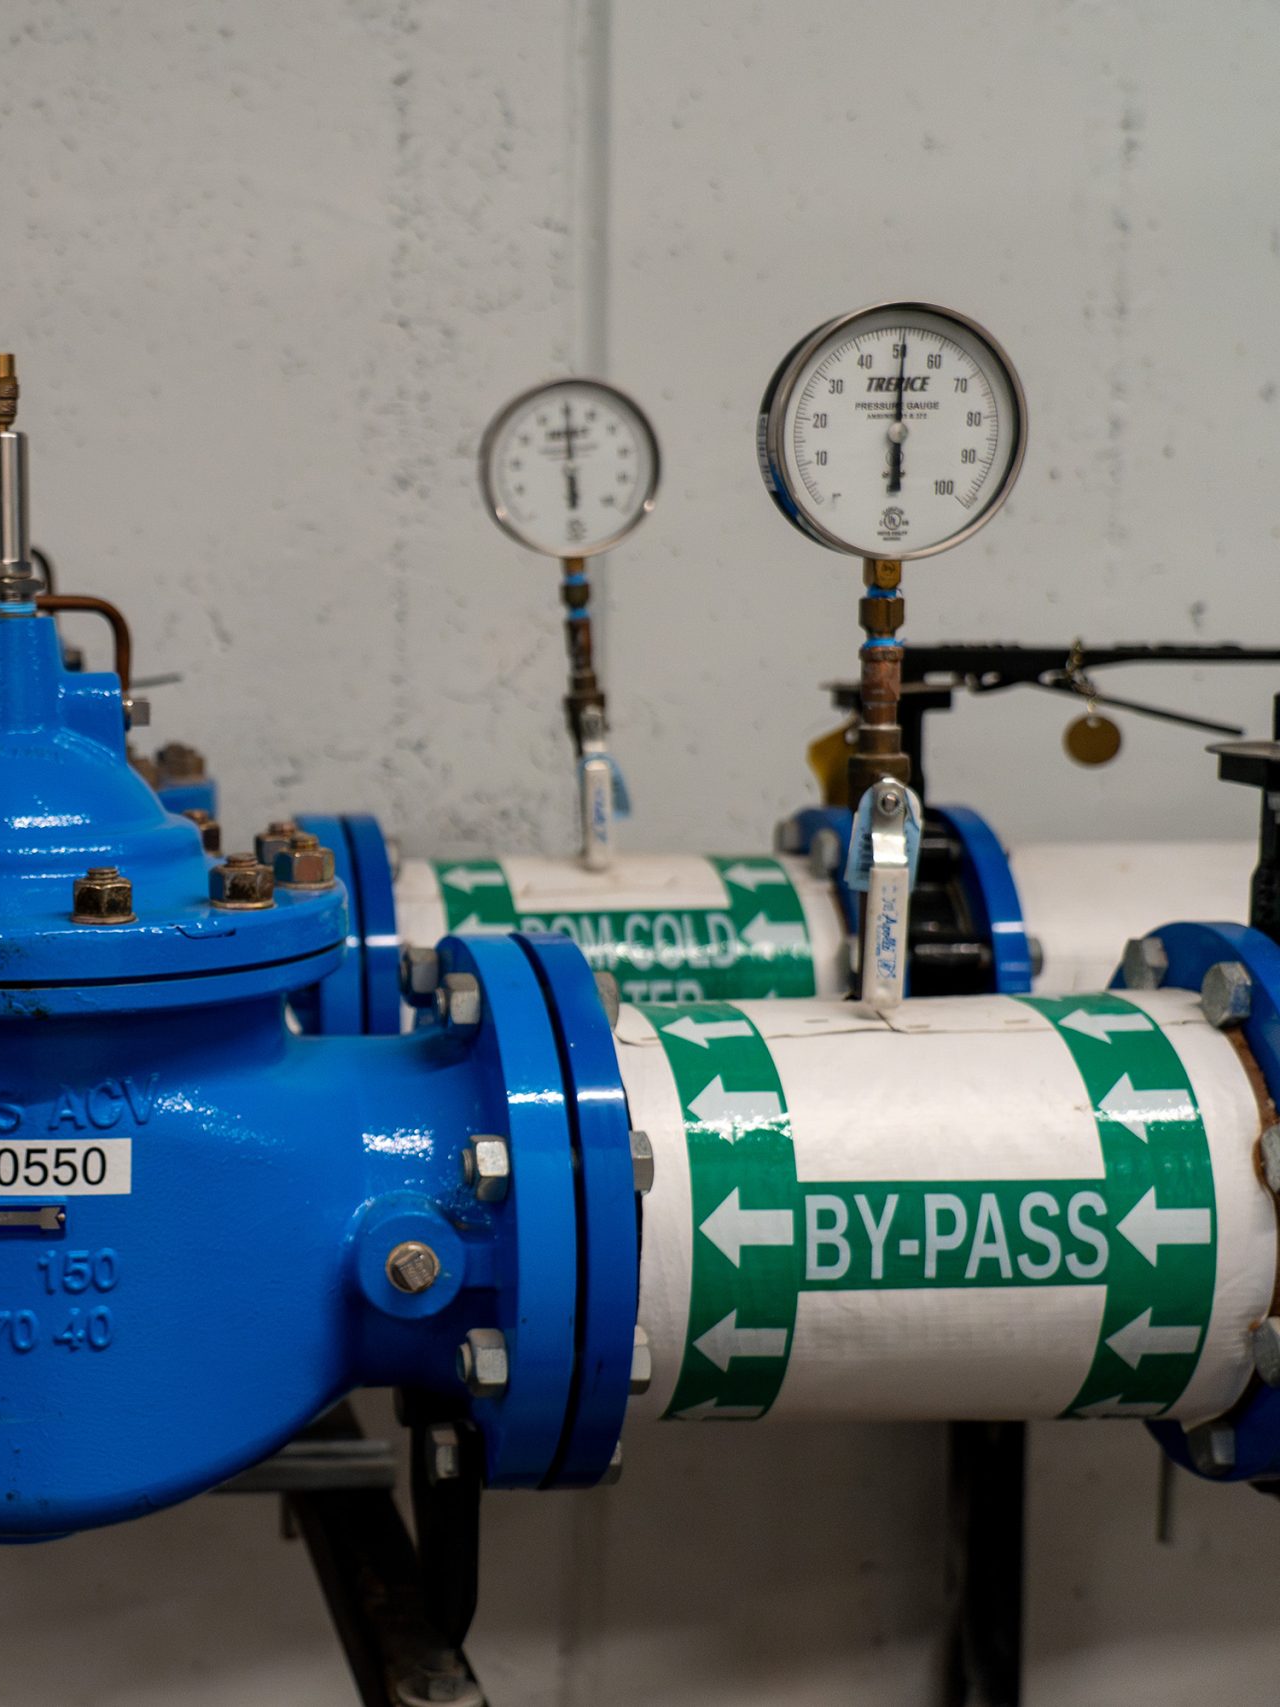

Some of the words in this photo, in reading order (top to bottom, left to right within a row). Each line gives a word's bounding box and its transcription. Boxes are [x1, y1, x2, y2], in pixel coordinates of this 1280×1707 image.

[857, 354, 872, 369] 40
[927, 354, 941, 370] 60
[829, 379, 843, 395] 30
[953, 378, 967, 393] 70
[855, 402, 902, 411] PRESSUR
[813, 413, 827, 429] 20
[966, 412, 981, 427] 80
[815, 451, 827, 466] 10
[961, 449, 976, 464] 90
[934, 480, 954, 495] 100
[624, 914, 738, 970] COLD
[48, 1073, 161, 1131] ACV
[805, 1191, 1109, 1280] BY-PASS
[37, 1247, 118, 1294] 150
[53, 1305, 113, 1352] 40
